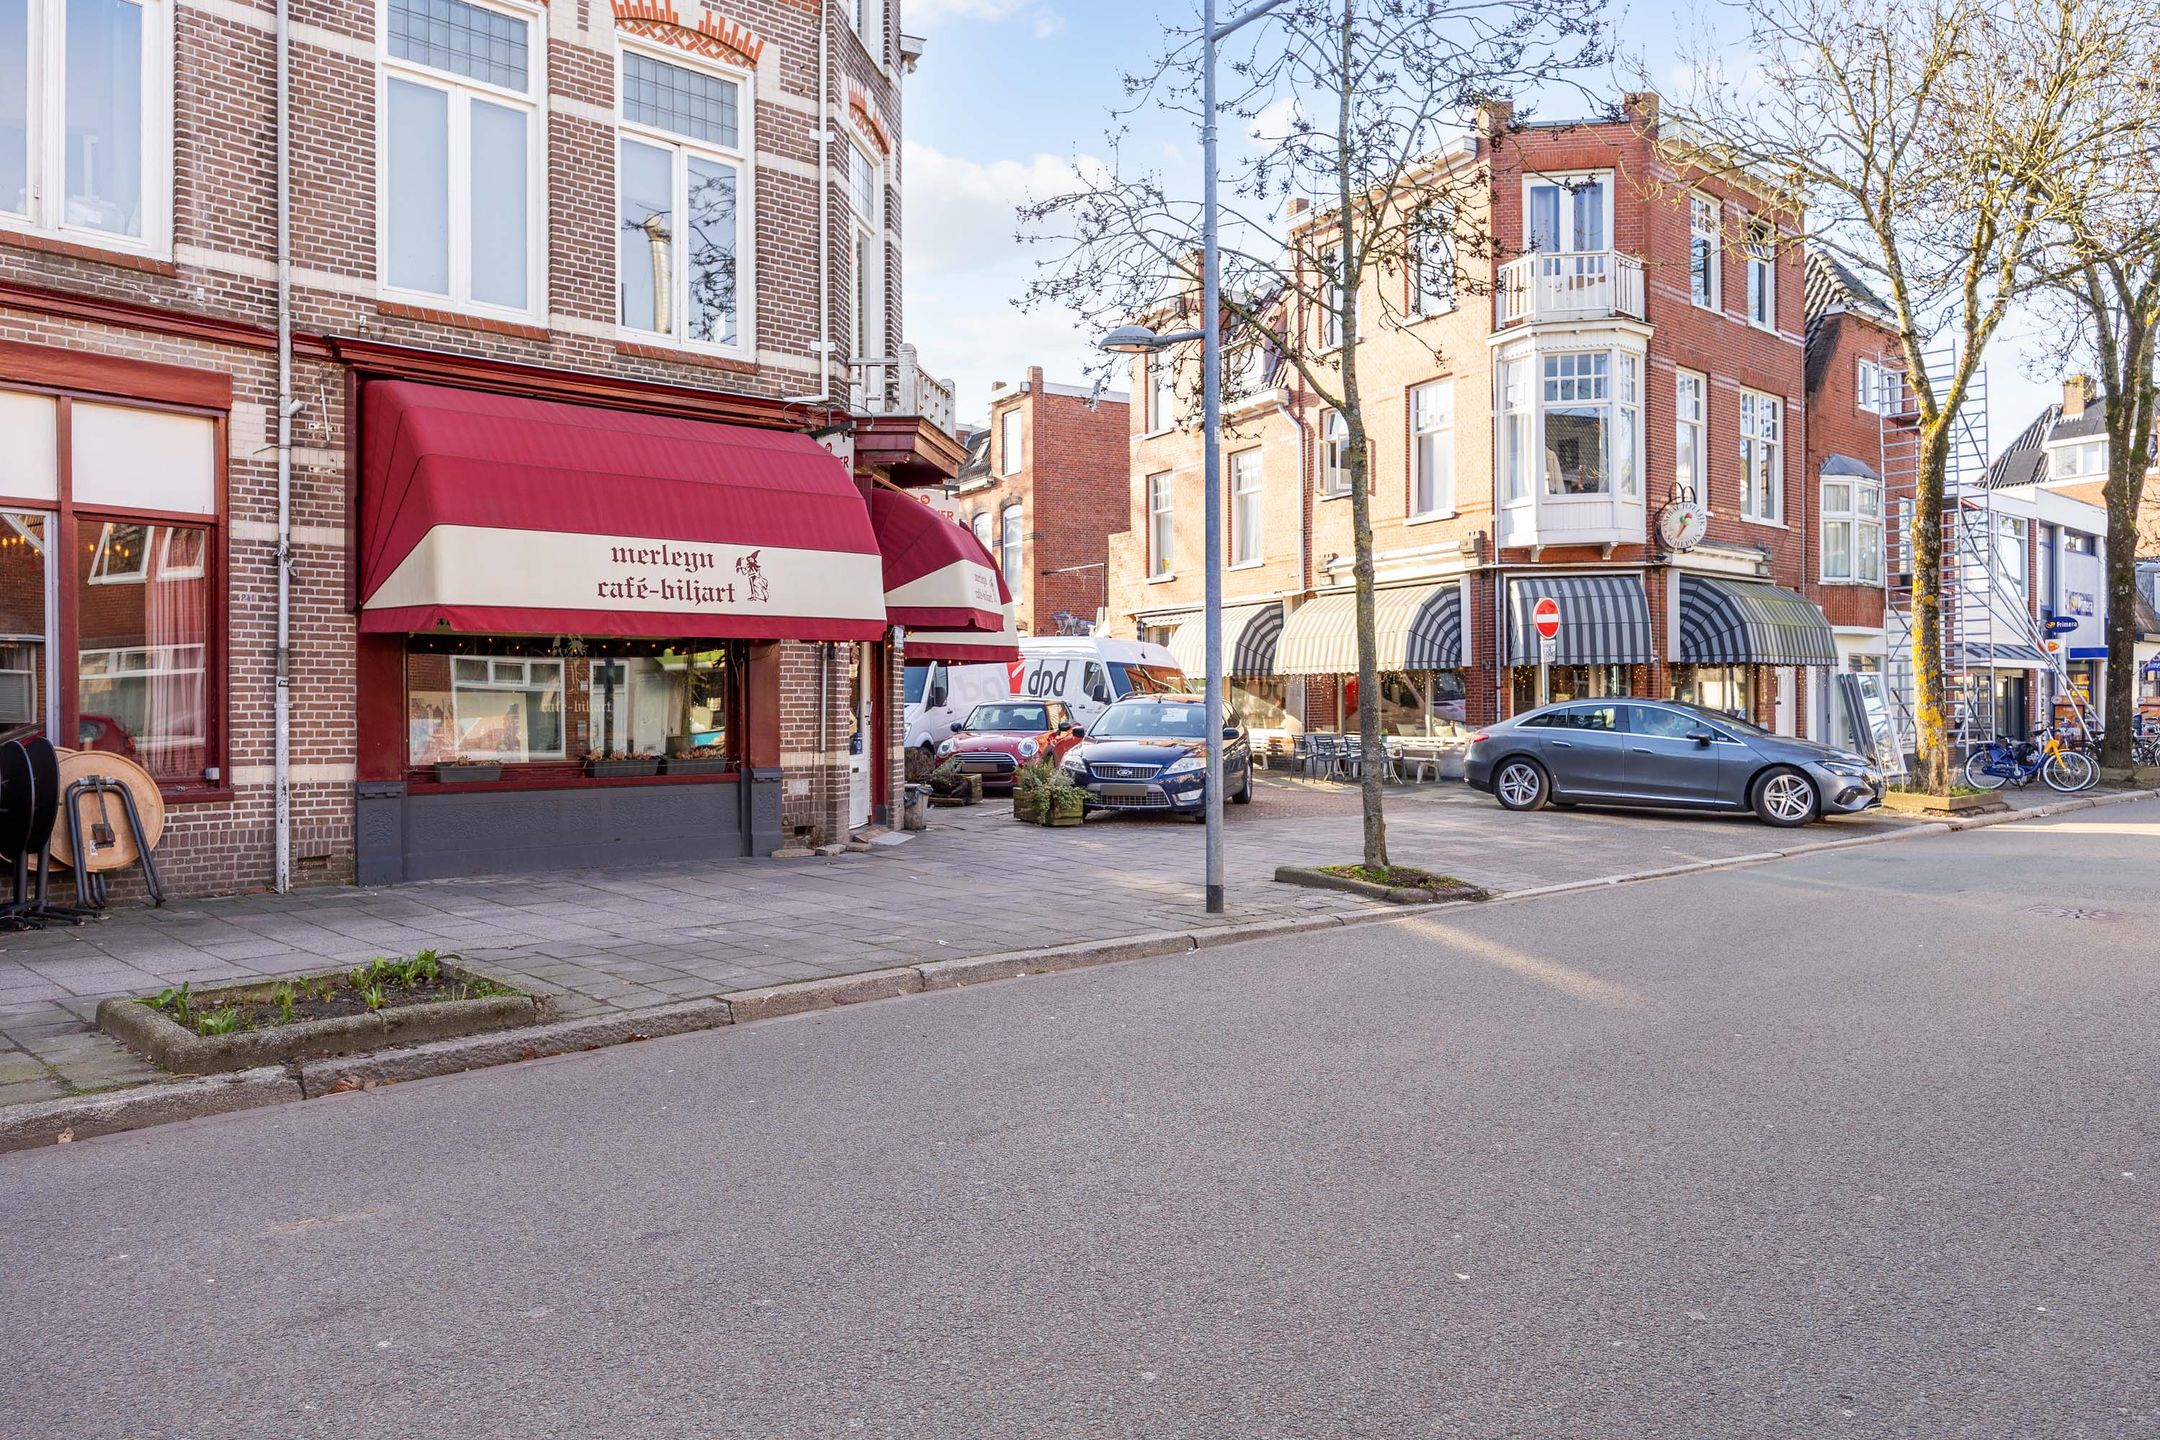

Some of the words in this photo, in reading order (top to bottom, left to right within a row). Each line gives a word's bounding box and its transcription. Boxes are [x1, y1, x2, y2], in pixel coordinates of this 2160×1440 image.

[611, 544, 714, 572] merleyn
[598, 577, 736, 606] café-biljart
[1028, 659, 1069, 697] dpd
